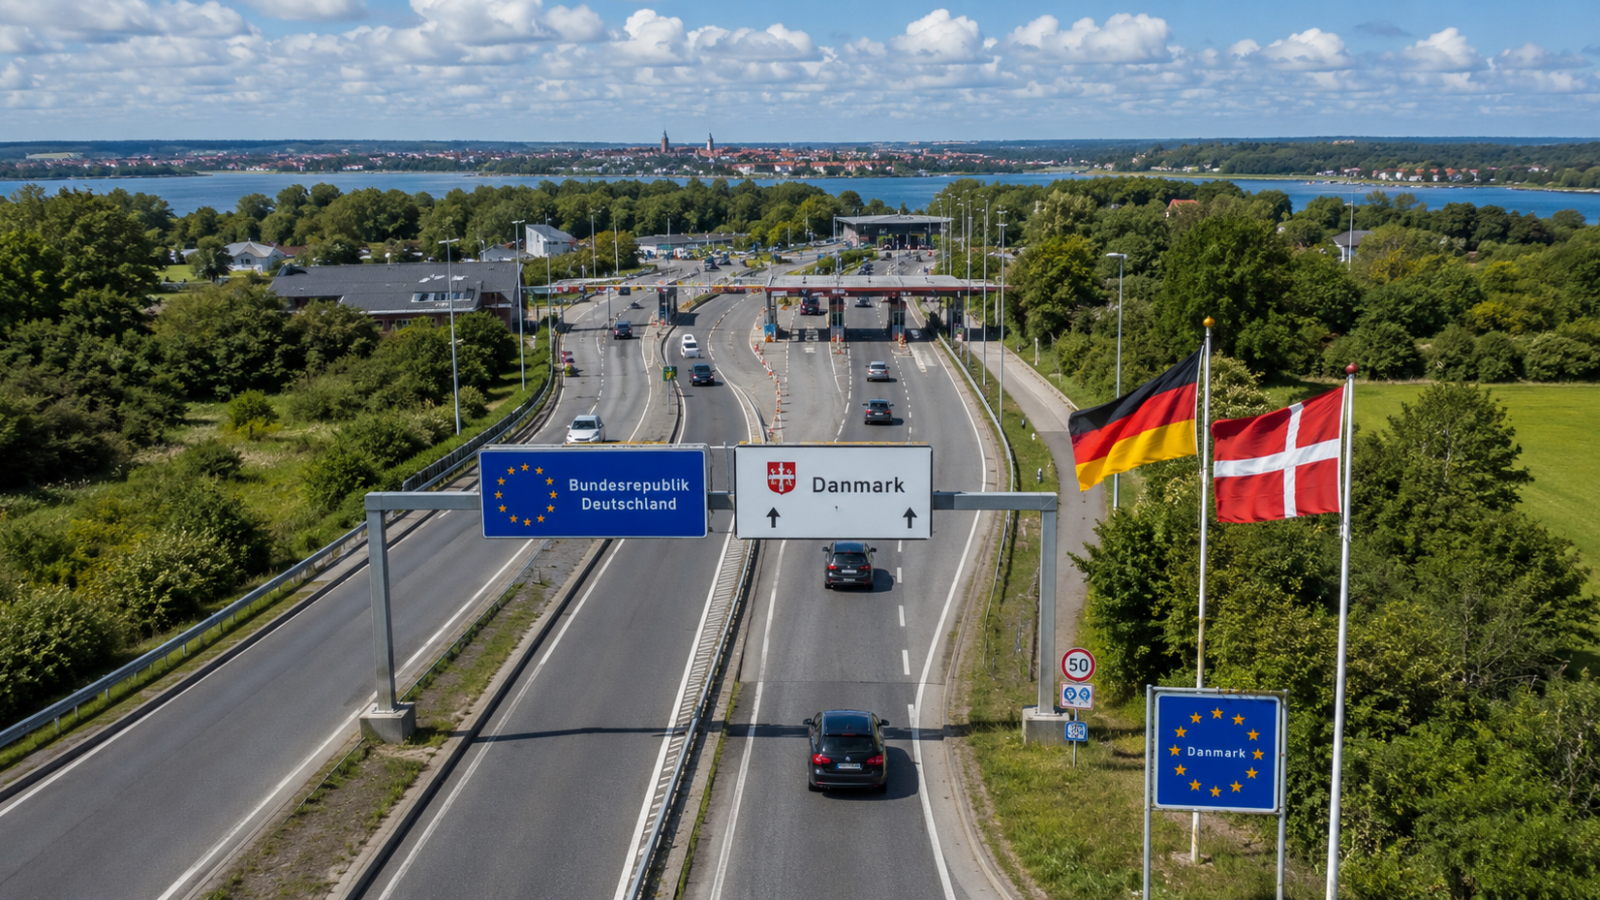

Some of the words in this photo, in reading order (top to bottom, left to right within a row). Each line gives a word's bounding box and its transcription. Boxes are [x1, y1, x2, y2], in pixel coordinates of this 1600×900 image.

[569, 478, 690, 494] Bundesrepublik
[813, 476, 905, 493] Danmark
[582, 497, 677, 511] Deutschland
[1069, 657, 1089, 672] 50
[1187, 746, 1246, 759] Danmark
